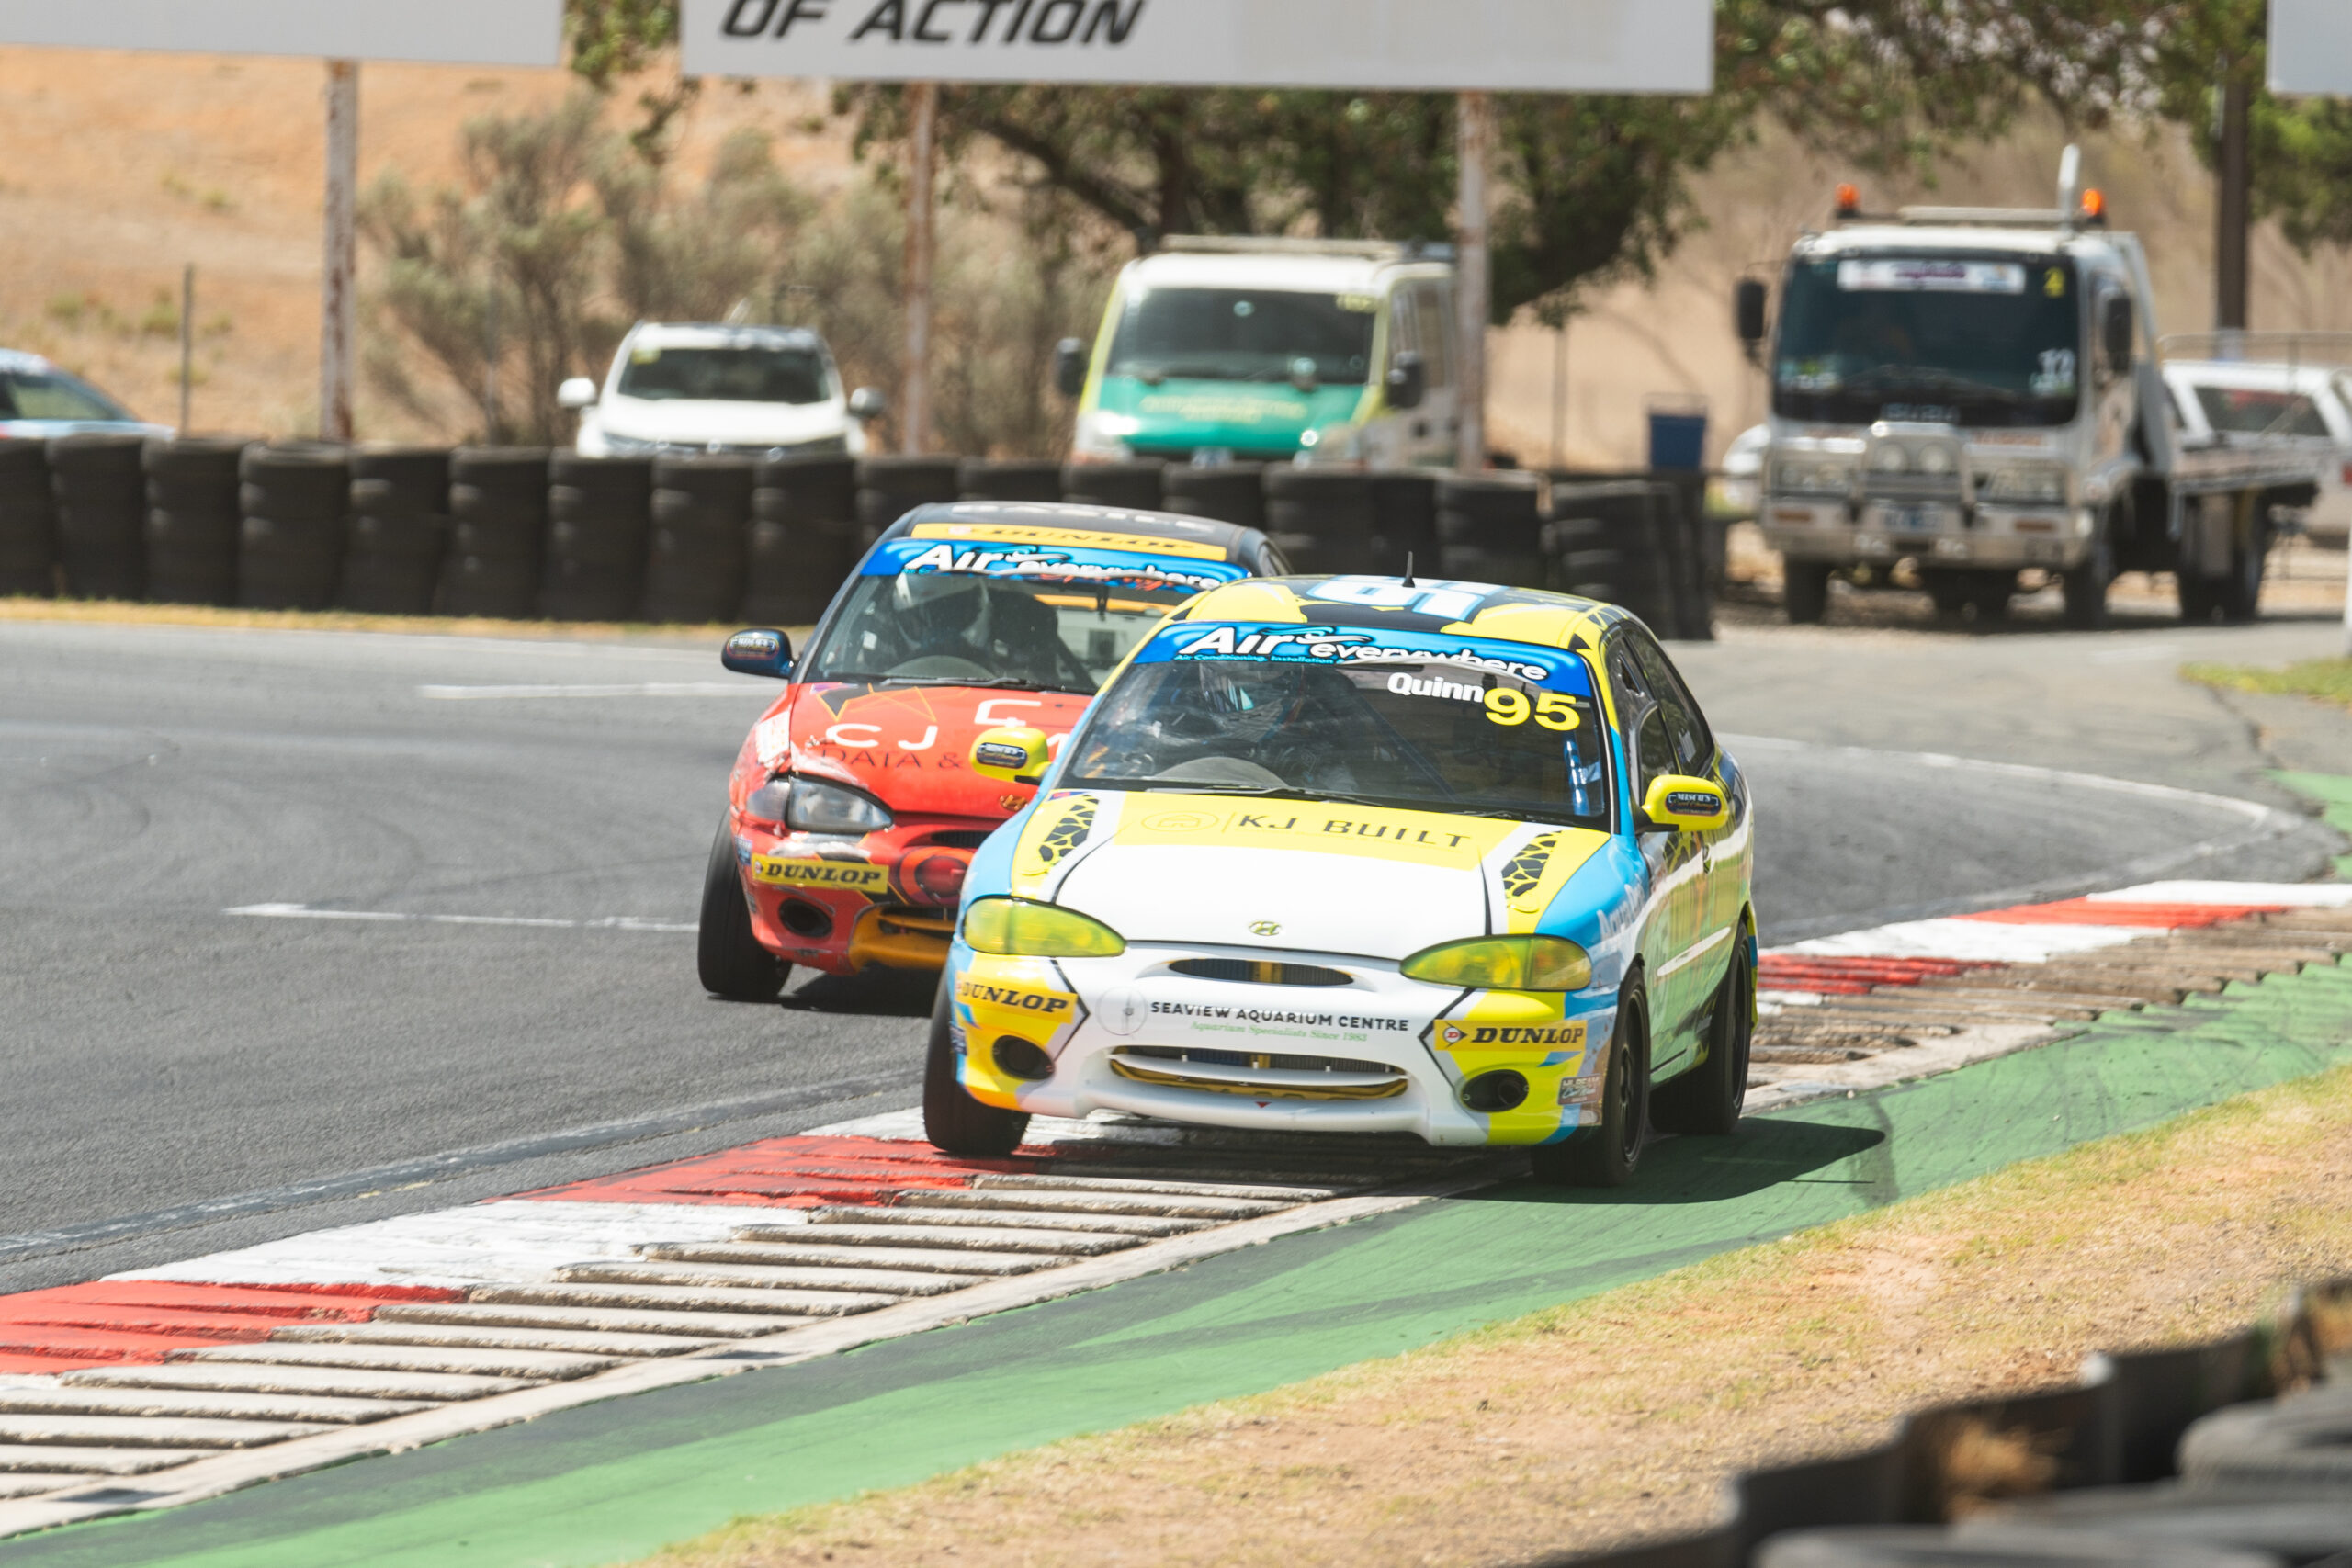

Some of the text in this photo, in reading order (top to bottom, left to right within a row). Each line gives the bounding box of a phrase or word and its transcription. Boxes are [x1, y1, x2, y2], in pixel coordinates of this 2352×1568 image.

[720, 0, 1146, 45] OF ACTION
[904, 544, 1004, 570] Air
[1178, 627, 1548, 681] Air everywhere
[1387, 672, 1580, 731] Quinn 95
[1239, 815, 1471, 848] KJ BUILT
[766, 863, 882, 885] DUNLOP
[1151, 1001, 1409, 1032] SEAVIEW AQUARIUM CENTRE
[1471, 1026, 1585, 1044] DUNLOP
